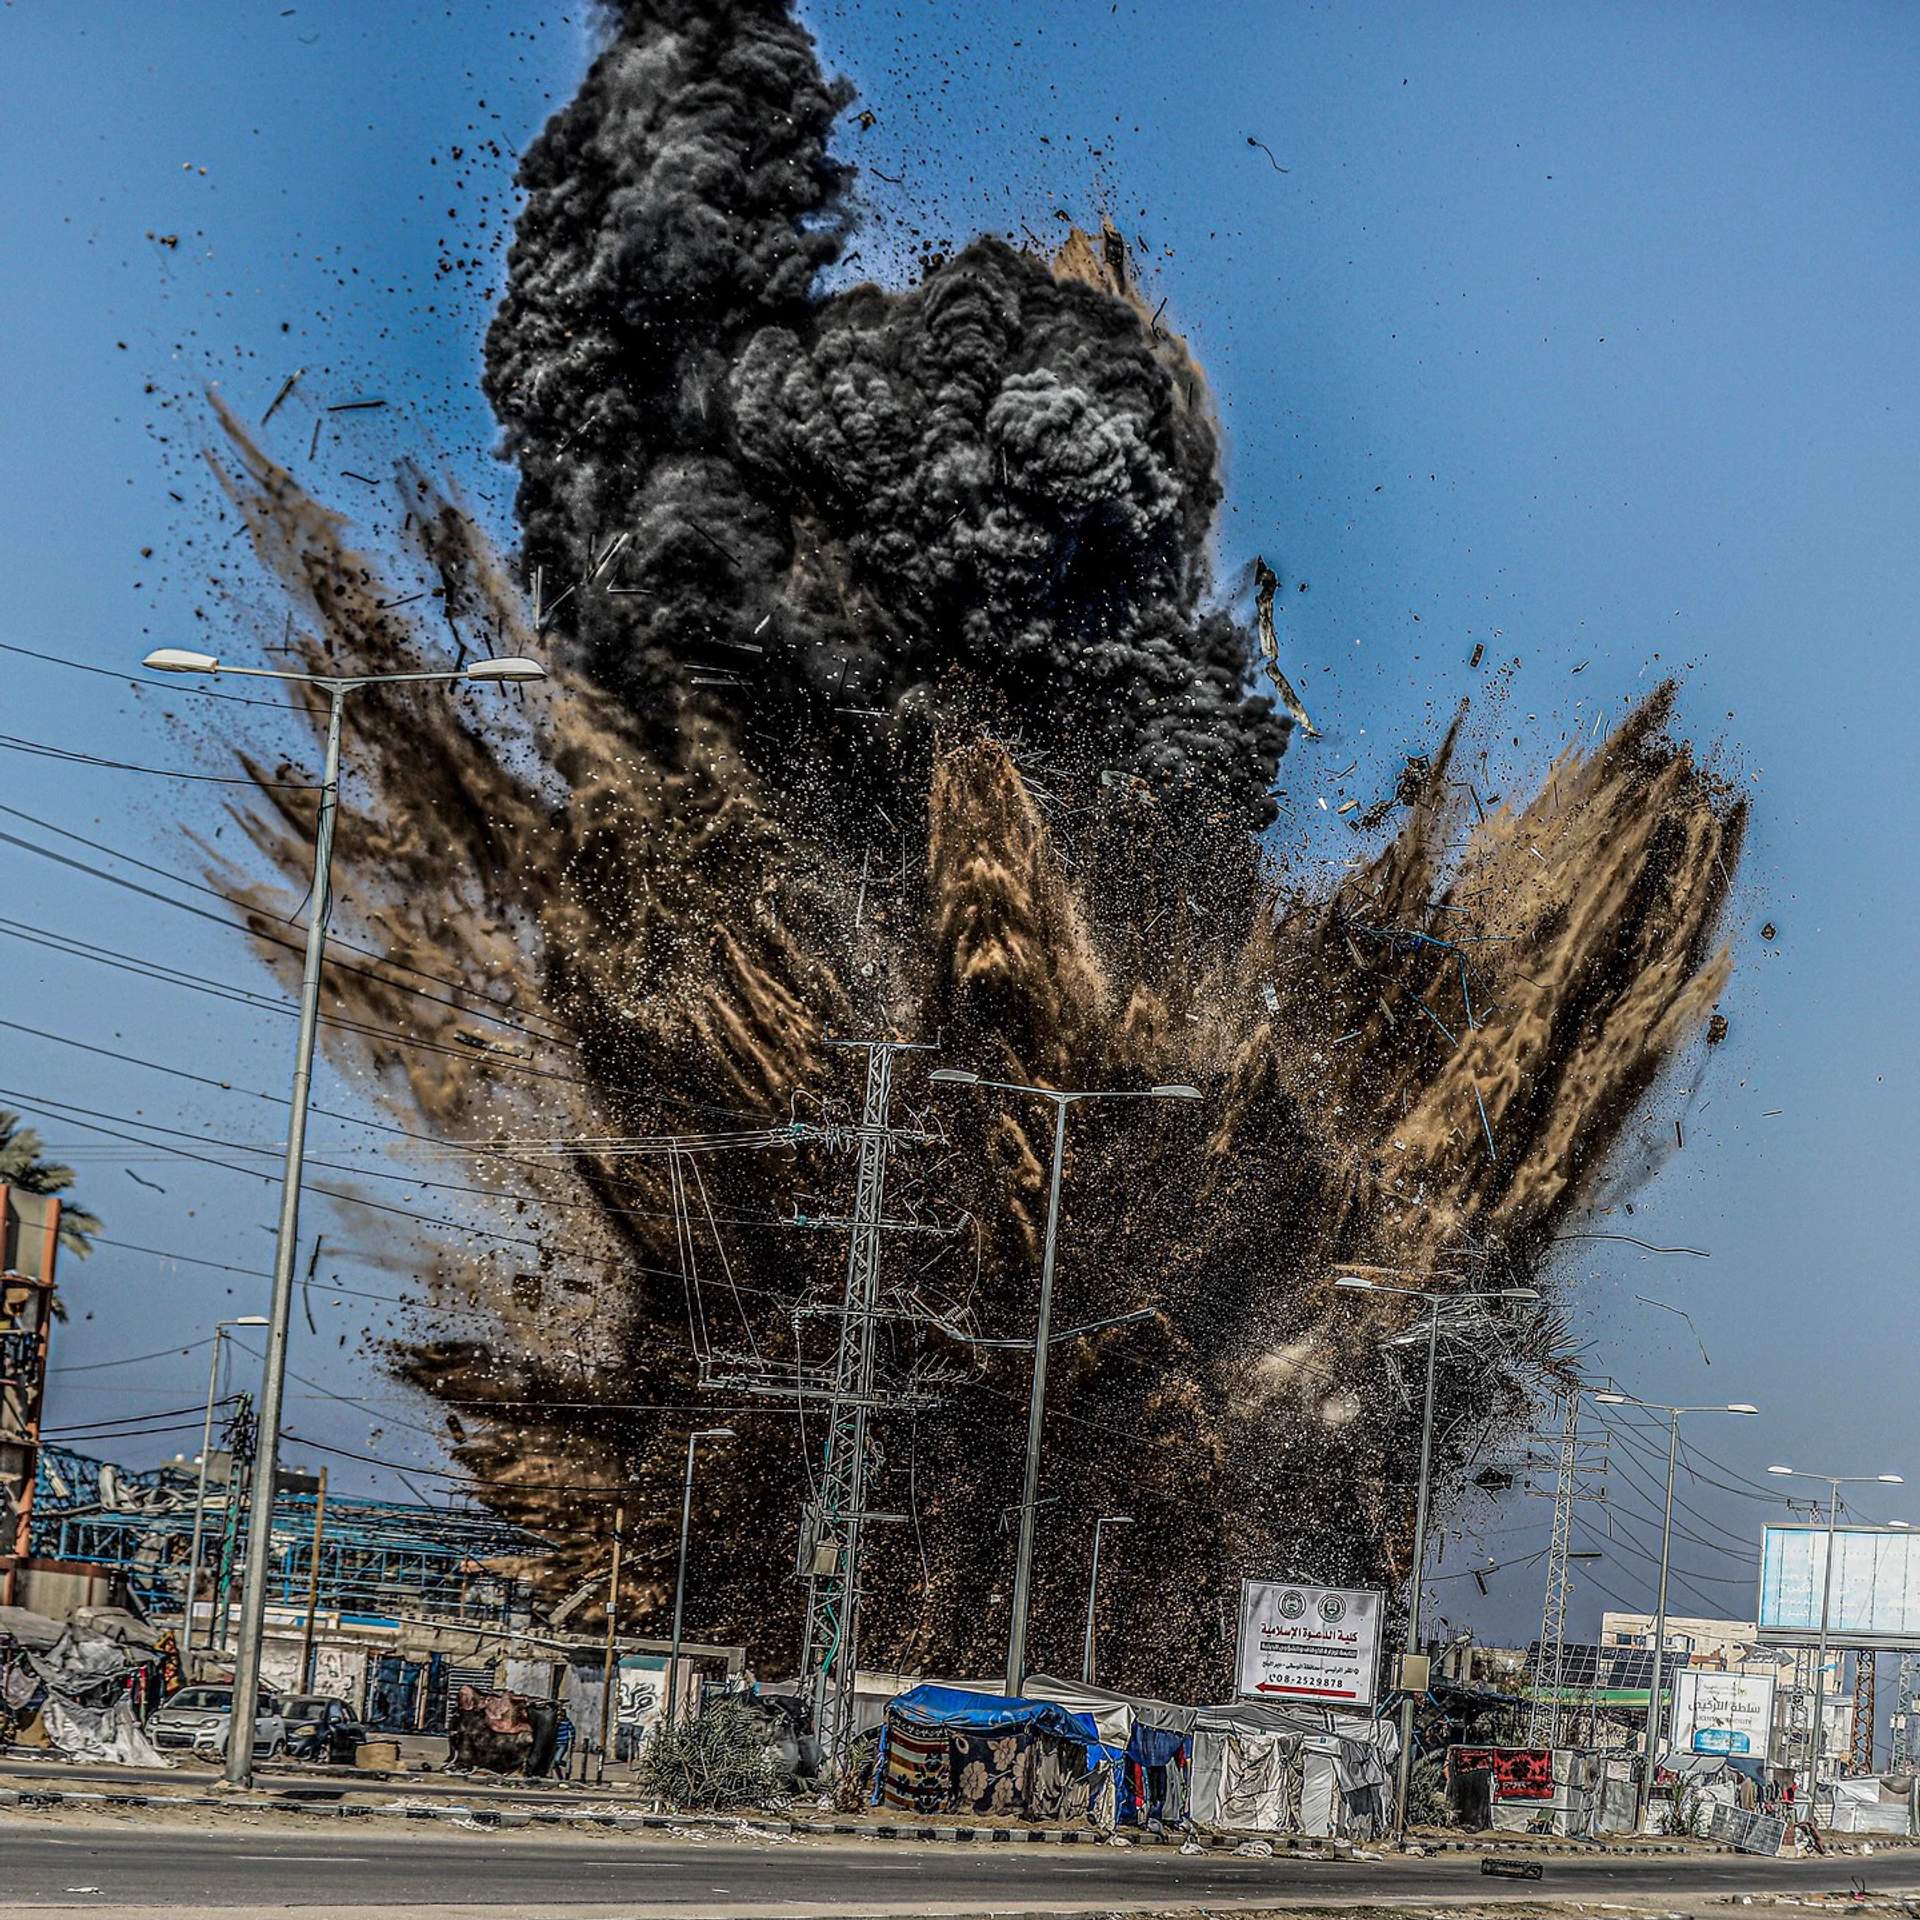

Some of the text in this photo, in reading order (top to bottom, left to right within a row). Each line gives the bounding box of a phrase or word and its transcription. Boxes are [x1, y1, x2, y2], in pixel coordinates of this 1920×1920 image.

[1260, 1623, 1358, 1644] كلية الدعوة الإسلامية
[1276, 1674, 1343, 1687] 08-2529878
